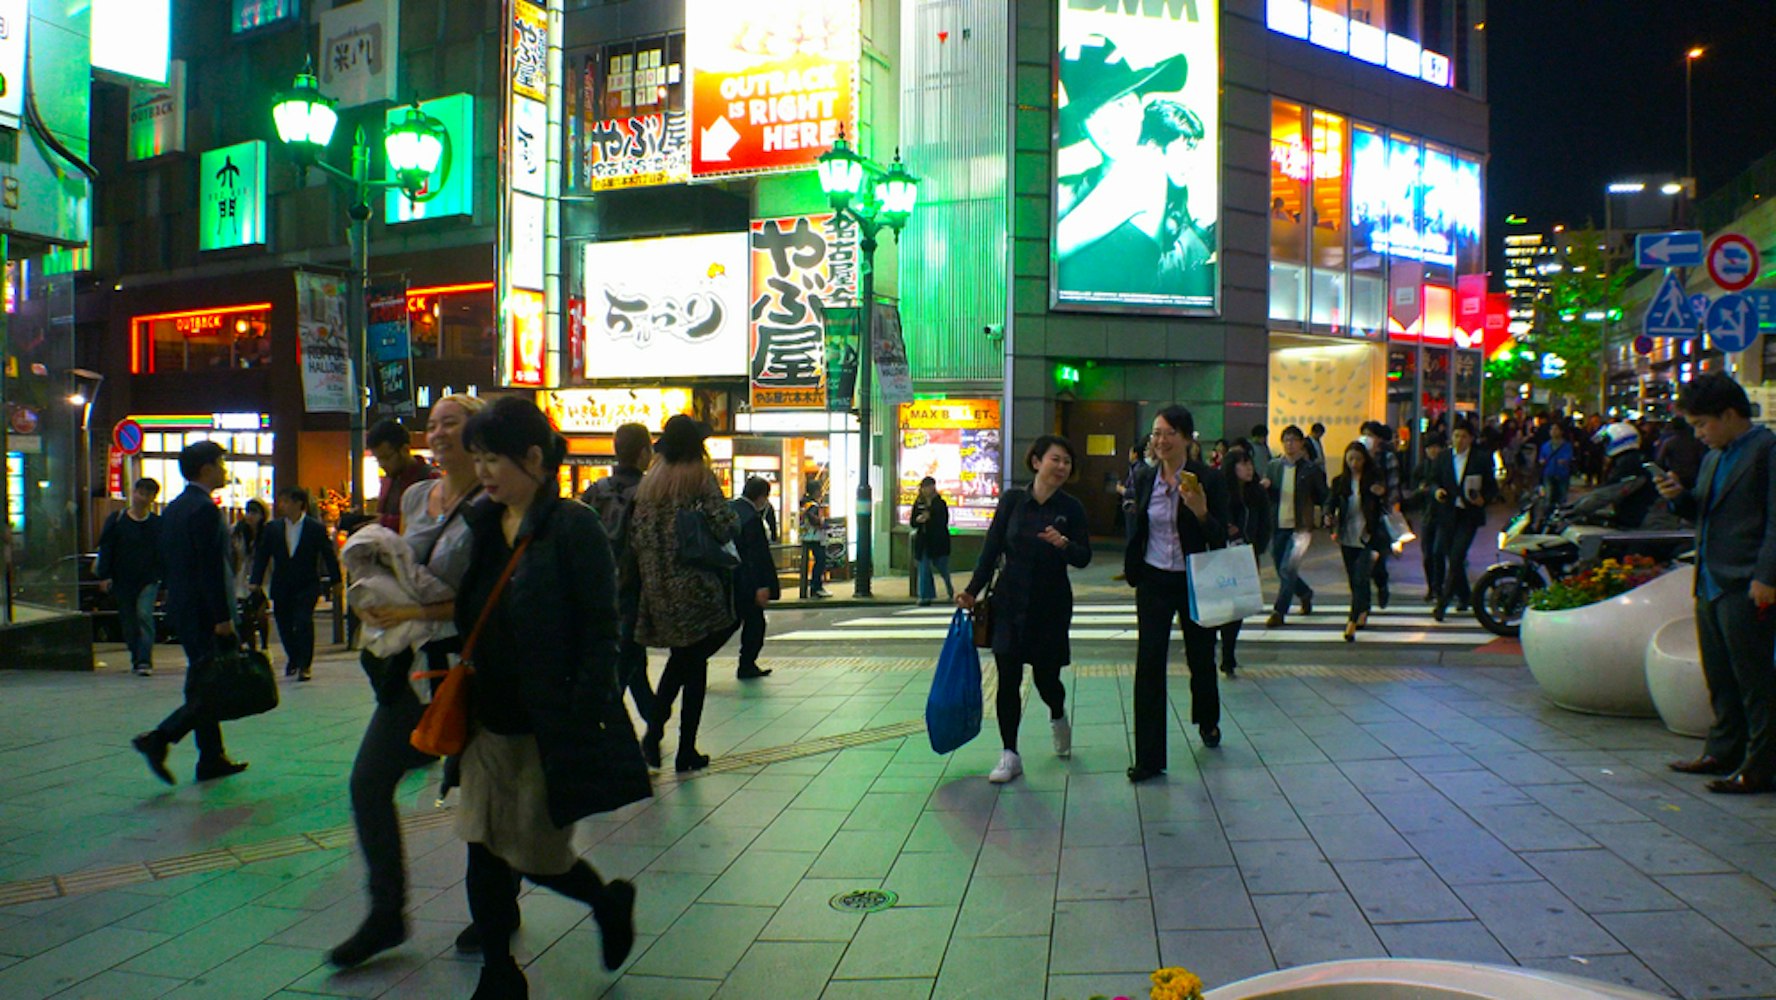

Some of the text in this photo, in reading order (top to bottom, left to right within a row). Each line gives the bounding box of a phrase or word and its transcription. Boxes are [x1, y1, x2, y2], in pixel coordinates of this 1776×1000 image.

[720, 64, 836, 100] OUTBACK
[728, 91, 838, 126] IS RIGHT
[763, 119, 837, 152] HERE
[752, 218, 826, 387] やぶ屋
[176, 315, 222, 331] OUTBACK
[910, 409, 937, 419] MAX
